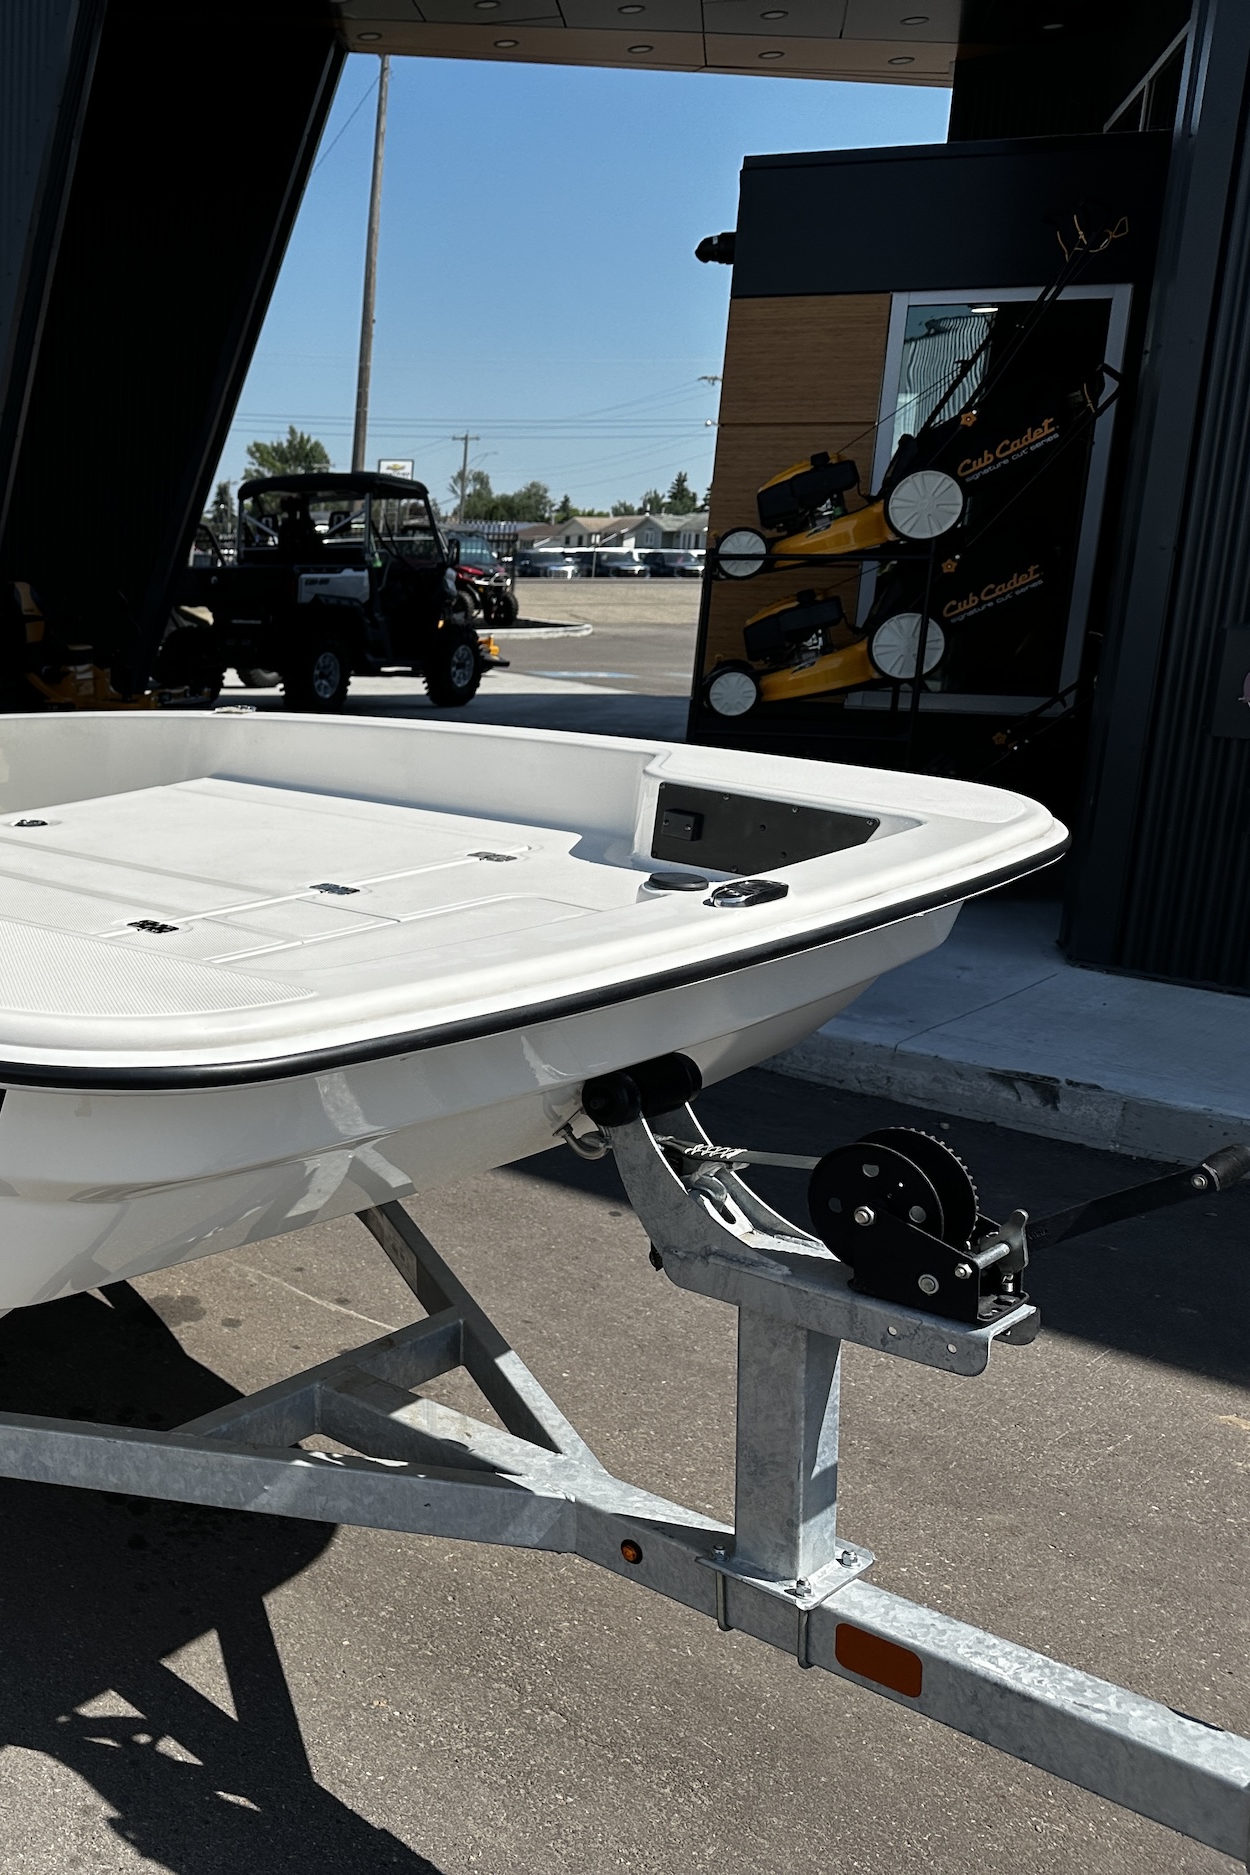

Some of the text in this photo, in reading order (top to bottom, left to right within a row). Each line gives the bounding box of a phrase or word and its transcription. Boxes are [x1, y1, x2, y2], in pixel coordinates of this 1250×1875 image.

[957, 417, 1056, 477] Cub Cadet
[965, 432, 1060, 483] signature cut series
[942, 563, 1041, 618] Cub Cadet
